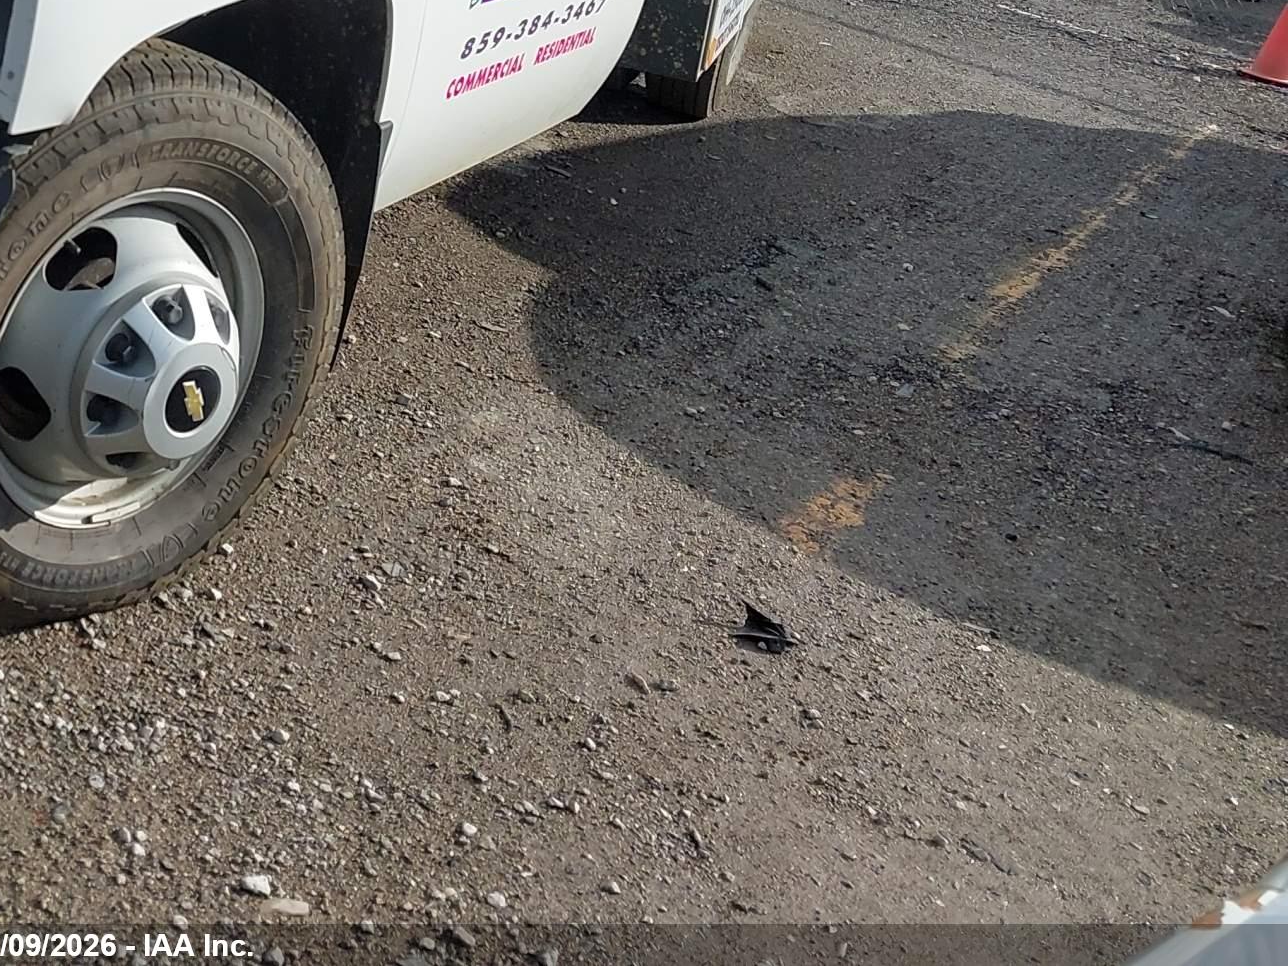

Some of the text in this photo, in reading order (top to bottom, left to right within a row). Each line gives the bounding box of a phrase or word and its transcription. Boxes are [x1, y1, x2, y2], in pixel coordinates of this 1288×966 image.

[445, 27, 597, 100] COMMERCIAL RESIDENTIAL
[151, 140, 258, 175] TRANSFORCE
[201, 324, 314, 525] Firestone
